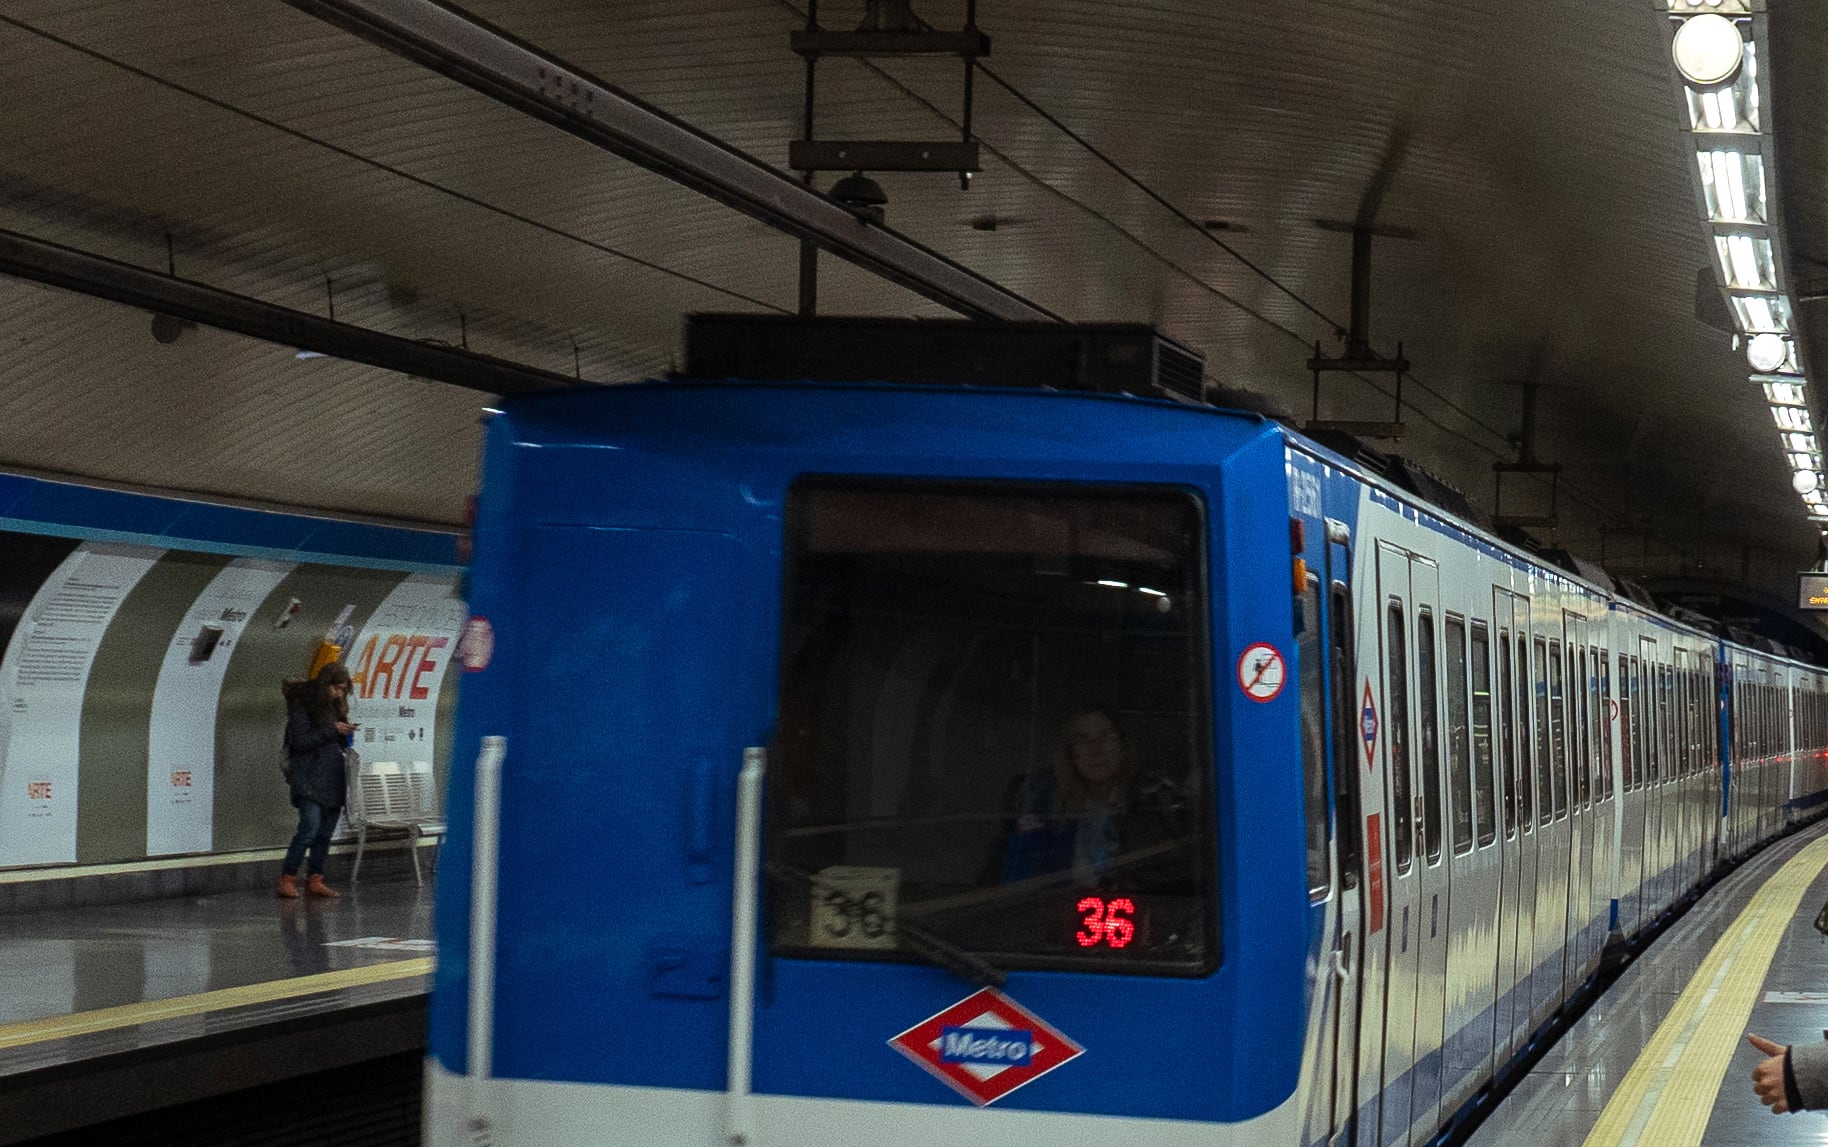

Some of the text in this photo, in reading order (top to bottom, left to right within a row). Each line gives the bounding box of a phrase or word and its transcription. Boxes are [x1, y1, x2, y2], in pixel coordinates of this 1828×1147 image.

[352, 633, 450, 700] ARTE
[1076, 897, 1135, 948] 36
[945, 1032, 1028, 1061] Metro
